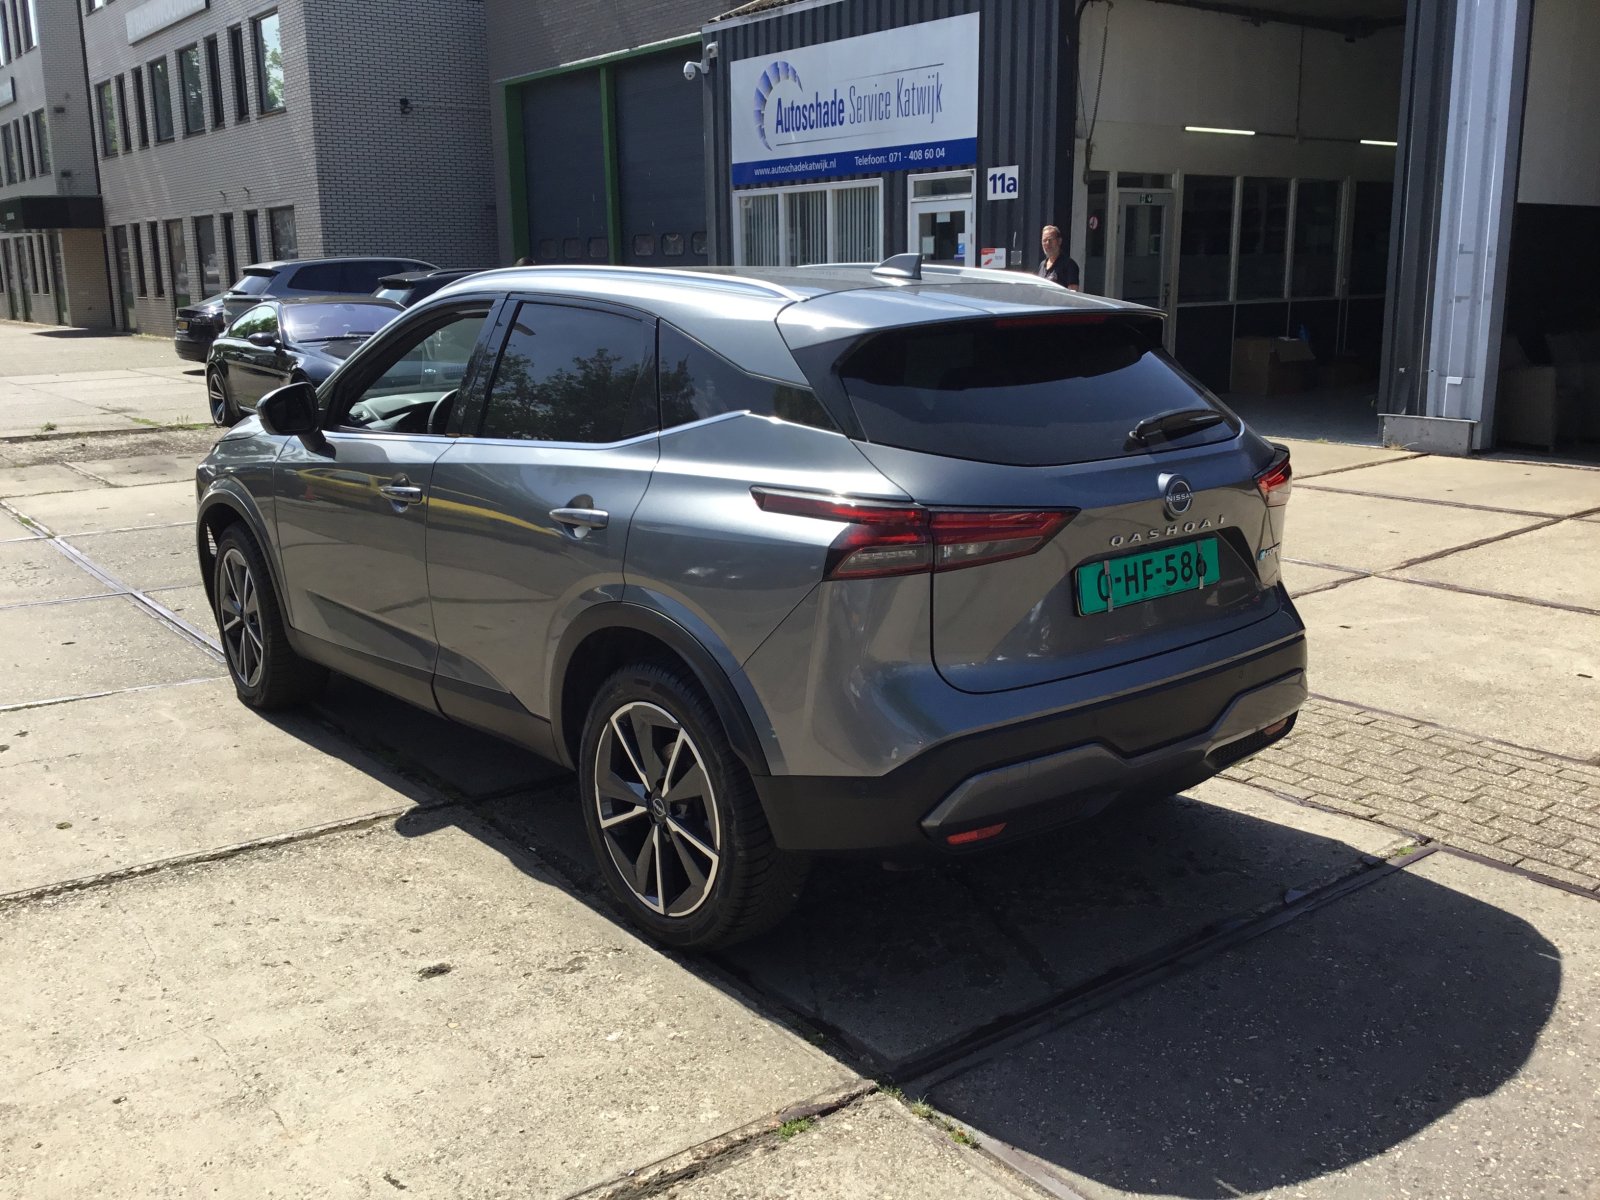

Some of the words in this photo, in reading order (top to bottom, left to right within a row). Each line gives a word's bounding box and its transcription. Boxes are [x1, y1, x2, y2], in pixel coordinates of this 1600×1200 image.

[776, 88, 845, 134] Autoschade
[849, 84, 891, 125] Service
[896, 71, 943, 124] Katwijk
[754, 158, 837, 176] www.autoschadekatwijk.nl
[854, 154, 887, 166] Telefoon:
[888, 151, 902, 163] 071
[909, 149, 923, 161] 408
[925, 148, 934, 160] 60
[936, 147, 946, 158] 04
[989, 173, 1018, 194] 11a
[1110, 513, 1225, 547] QASHQAI
